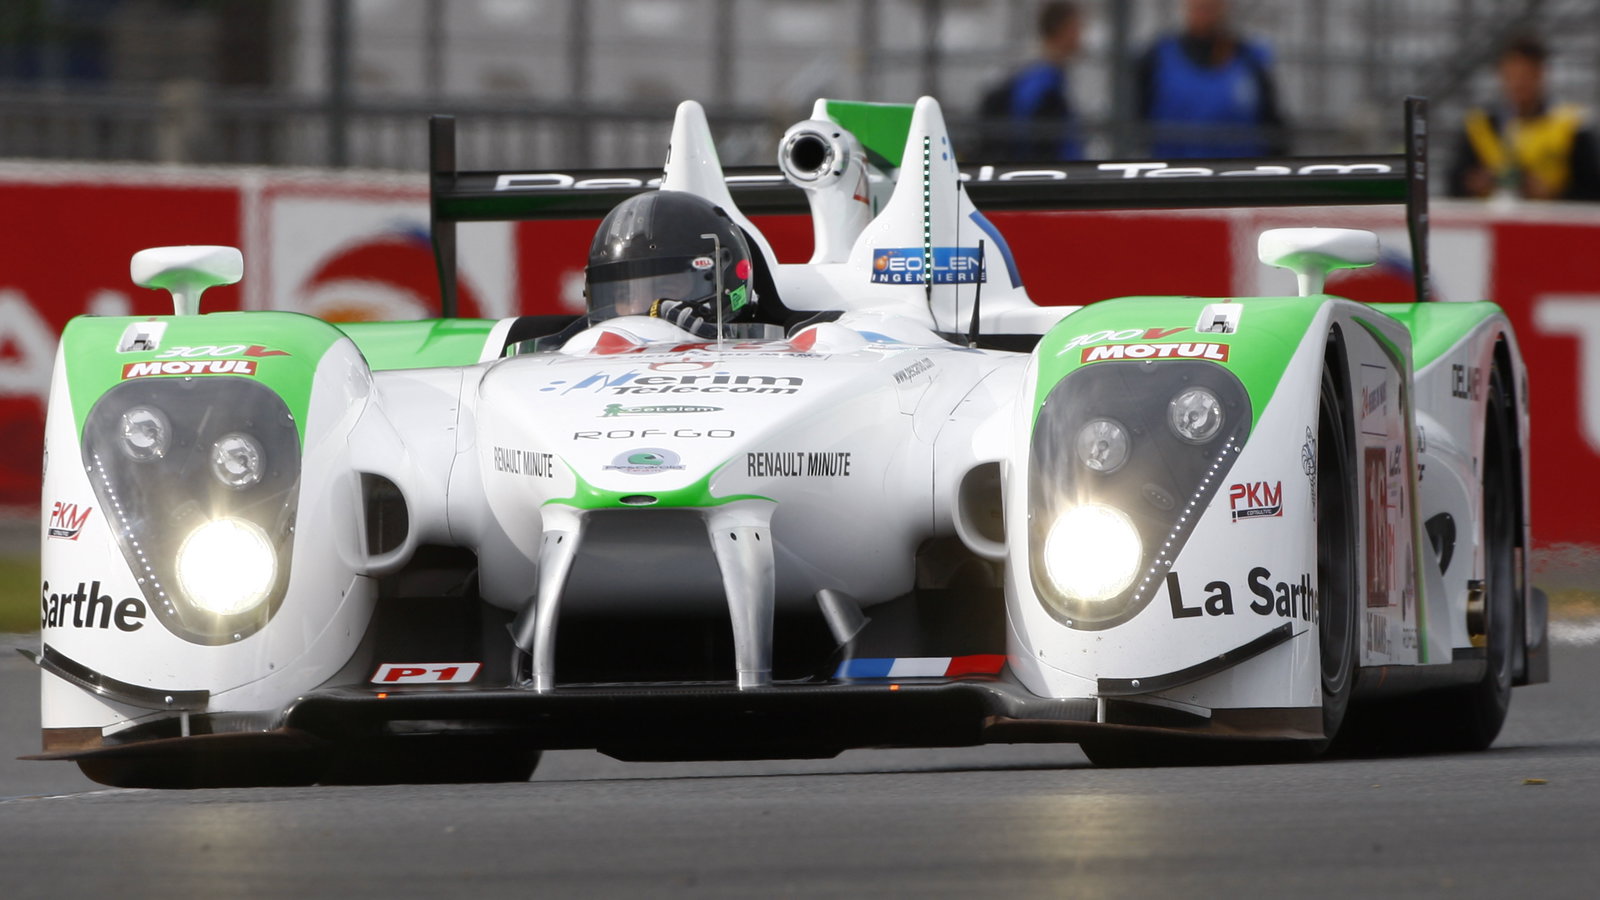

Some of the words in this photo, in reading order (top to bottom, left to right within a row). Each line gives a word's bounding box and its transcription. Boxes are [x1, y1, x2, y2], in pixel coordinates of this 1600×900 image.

[154, 344, 292, 358] 300V
[1056, 327, 1192, 357] 300V
[1086, 343, 1225, 361] MOTUL
[126, 360, 252, 378] MOTUL
[561, 369, 804, 394] Nerim
[611, 384, 799, 395] Telecom
[573, 428, 736, 441] ROFGO
[494, 446, 521, 475] RENAULT
[523, 450, 553, 478] MINUTE
[747, 452, 804, 477] RENAULT
[807, 452, 851, 477] MINUTE
[1230, 481, 1282, 510] PKM
[49, 501, 93, 530] PKM
[1166, 571, 1235, 619] La
[382, 667, 460, 682] P1
